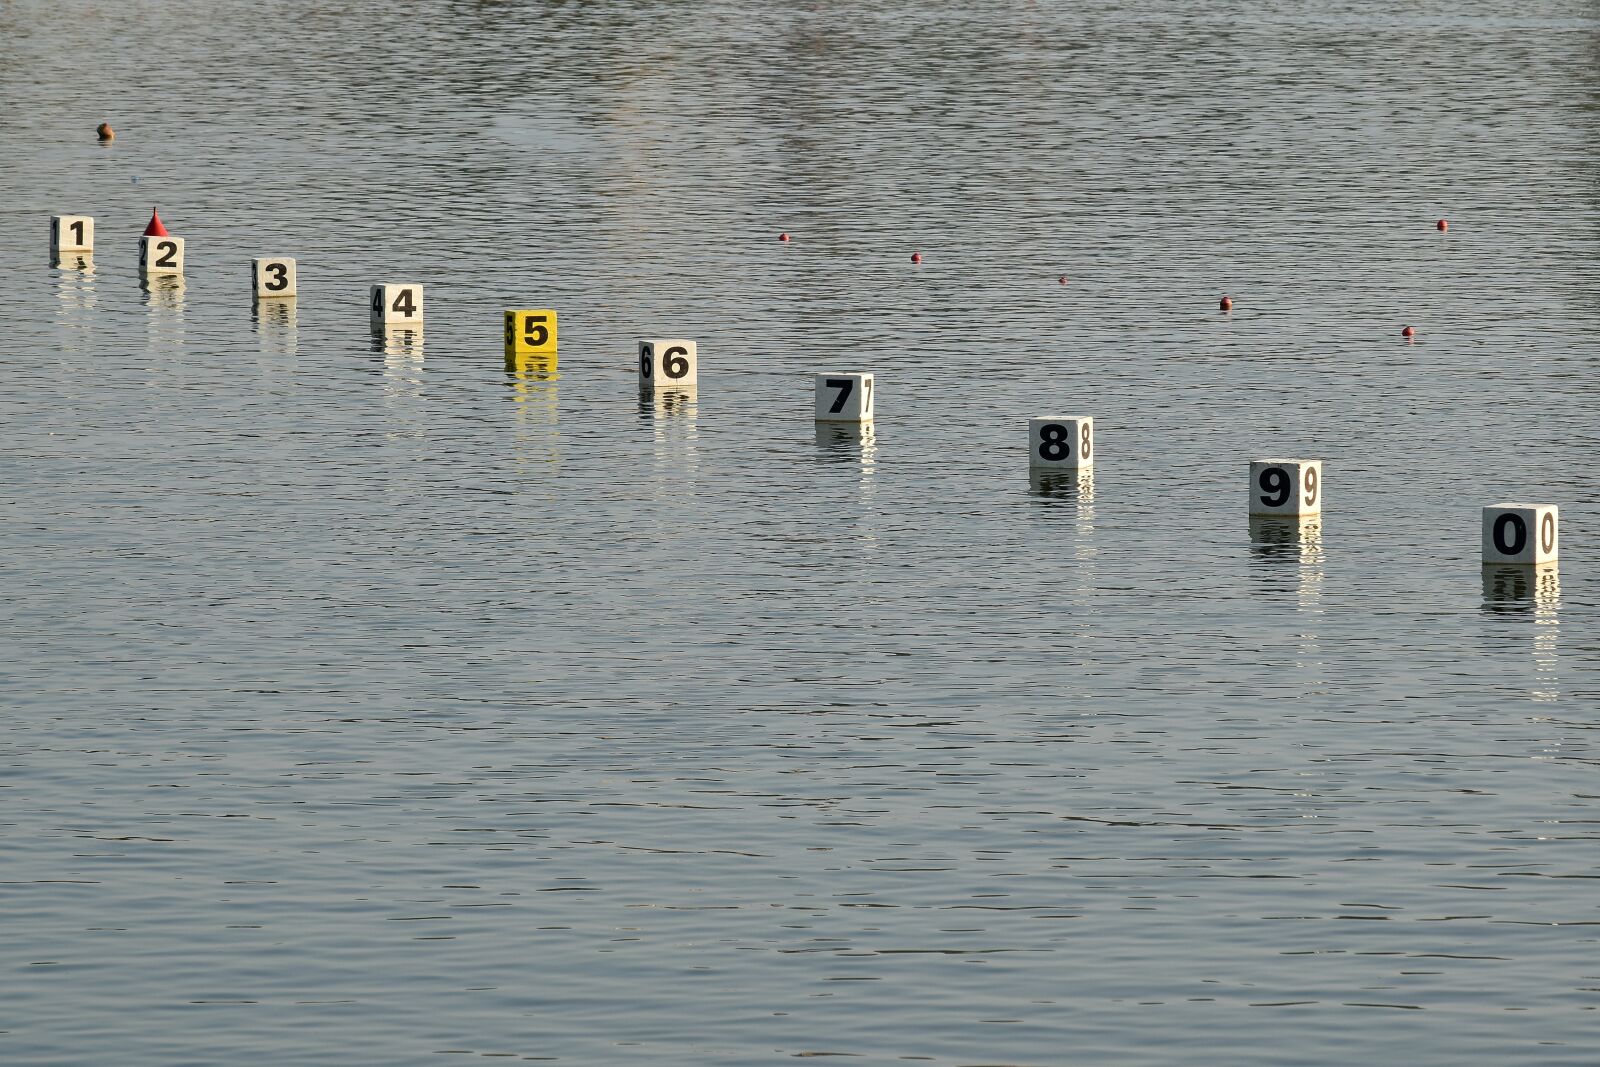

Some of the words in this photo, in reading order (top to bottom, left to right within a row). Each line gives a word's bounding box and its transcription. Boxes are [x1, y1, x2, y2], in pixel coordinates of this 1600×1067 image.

[70, 220, 84, 246] 1
[140, 240, 147, 266] 2
[155, 241, 178, 268] 2
[264, 263, 289, 291] 3
[372, 288, 384, 318] 4
[392, 289, 417, 318] 4
[506, 315, 513, 346] 5
[524, 315, 549, 346] 5
[641, 346, 651, 379] 6
[662, 346, 689, 379] 6
[826, 379, 854, 413] 7
[864, 379, 872, 413] 7
[1038, 423, 1070, 461] 8
[1081, 422, 1090, 460] 8
[1259, 467, 1291, 507] 9
[1304, 466, 1318, 507] 9
[1492, 512, 1527, 556] 0
[1541, 511, 1554, 555] 0
